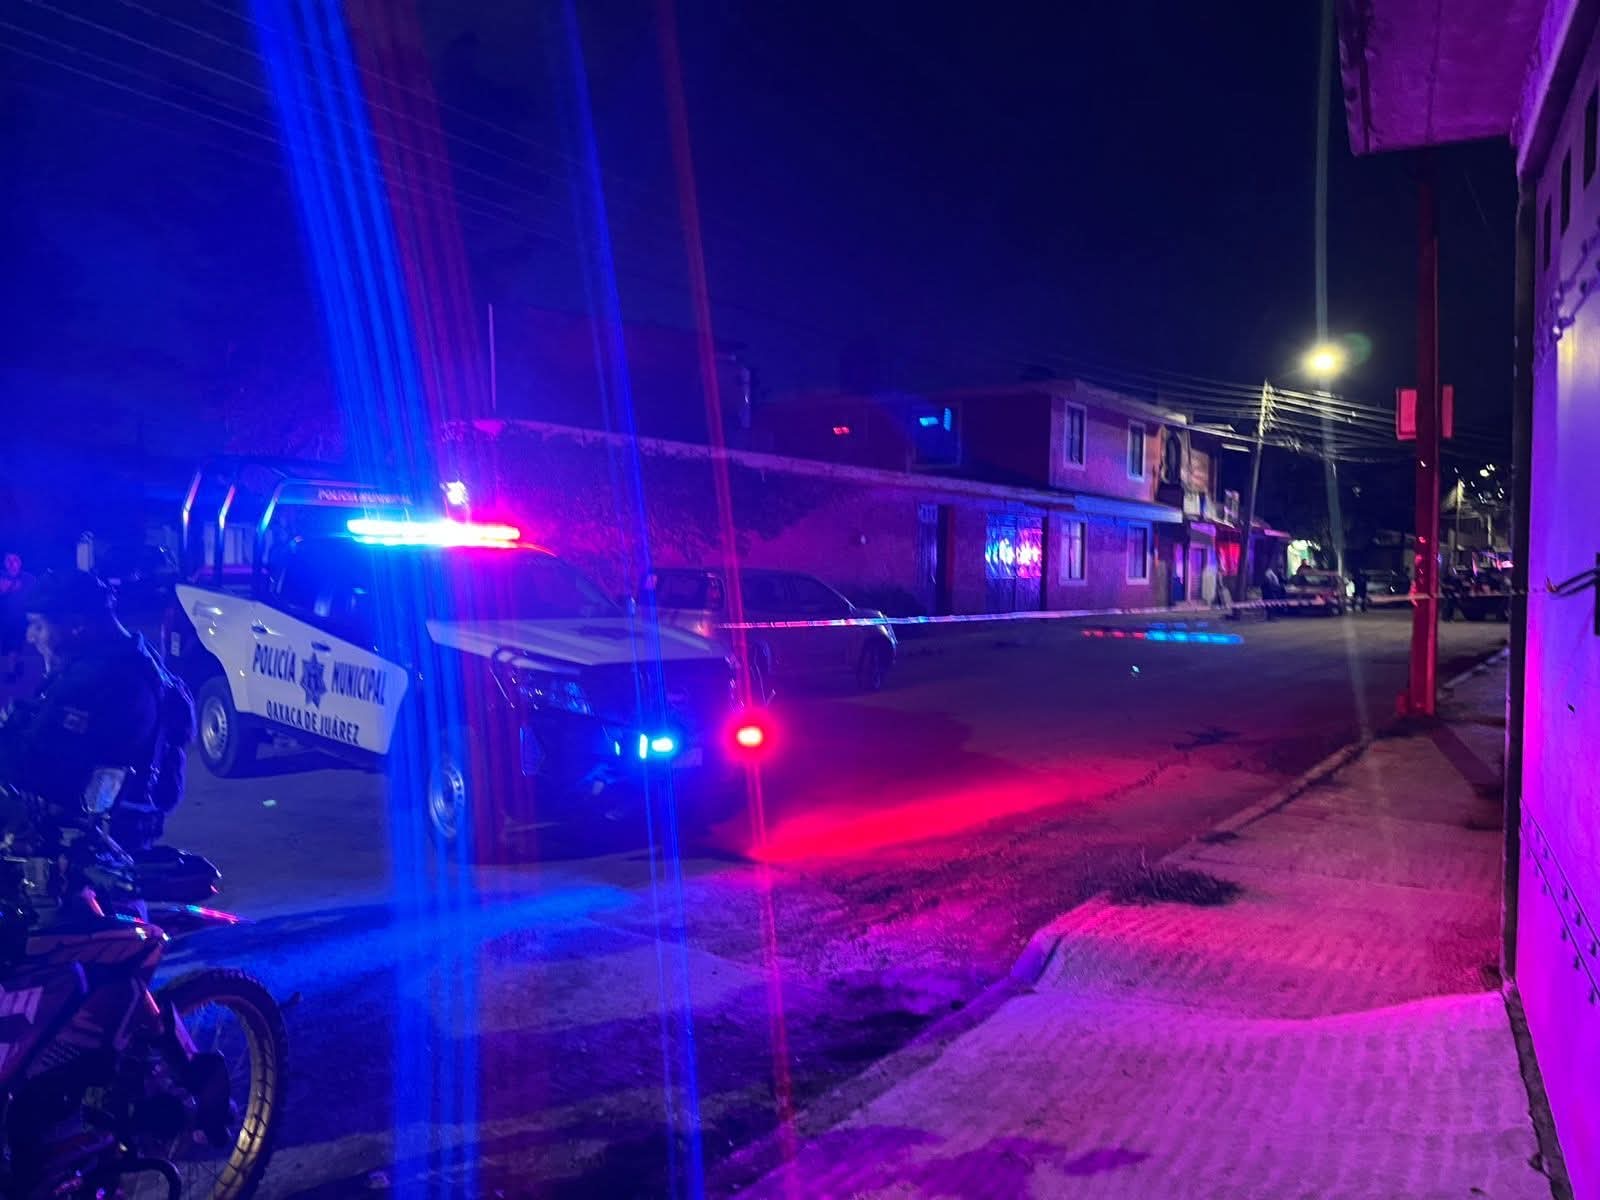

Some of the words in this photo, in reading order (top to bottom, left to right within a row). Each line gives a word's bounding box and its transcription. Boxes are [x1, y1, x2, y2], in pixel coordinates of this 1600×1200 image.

[253, 643, 296, 682] POLICÍA
[331, 661, 387, 705] MUNICIPAL
[266, 700, 302, 728] OAXACA
[304, 708, 317, 731] DE
[320, 715, 360, 744] JUÁREZ
